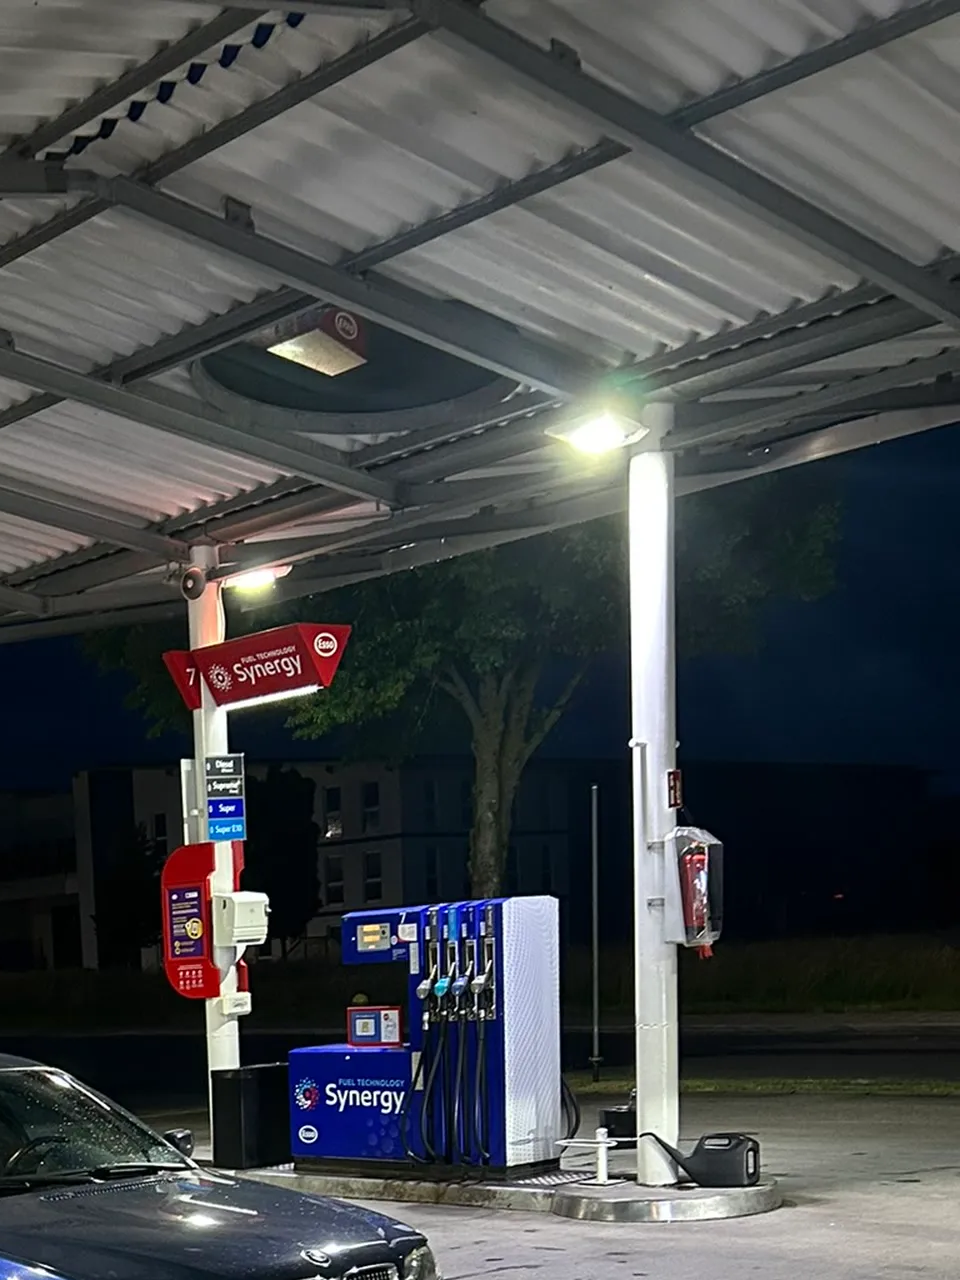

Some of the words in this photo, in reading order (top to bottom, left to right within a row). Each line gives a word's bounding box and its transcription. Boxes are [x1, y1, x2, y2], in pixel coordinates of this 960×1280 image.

[240, 655, 257, 664] FUEL
[256, 645, 297, 661] TECHNOLOGY
[186, 667, 196, 686] 7
[233, 654, 302, 685] Synergy
[218, 803, 236, 814] Super
[215, 825, 231, 835] Super
[338, 1078, 356, 1086] FUEL
[357, 1078, 405, 1087] TECHNOLOGY
[325, 1083, 405, 1114] Synergy
